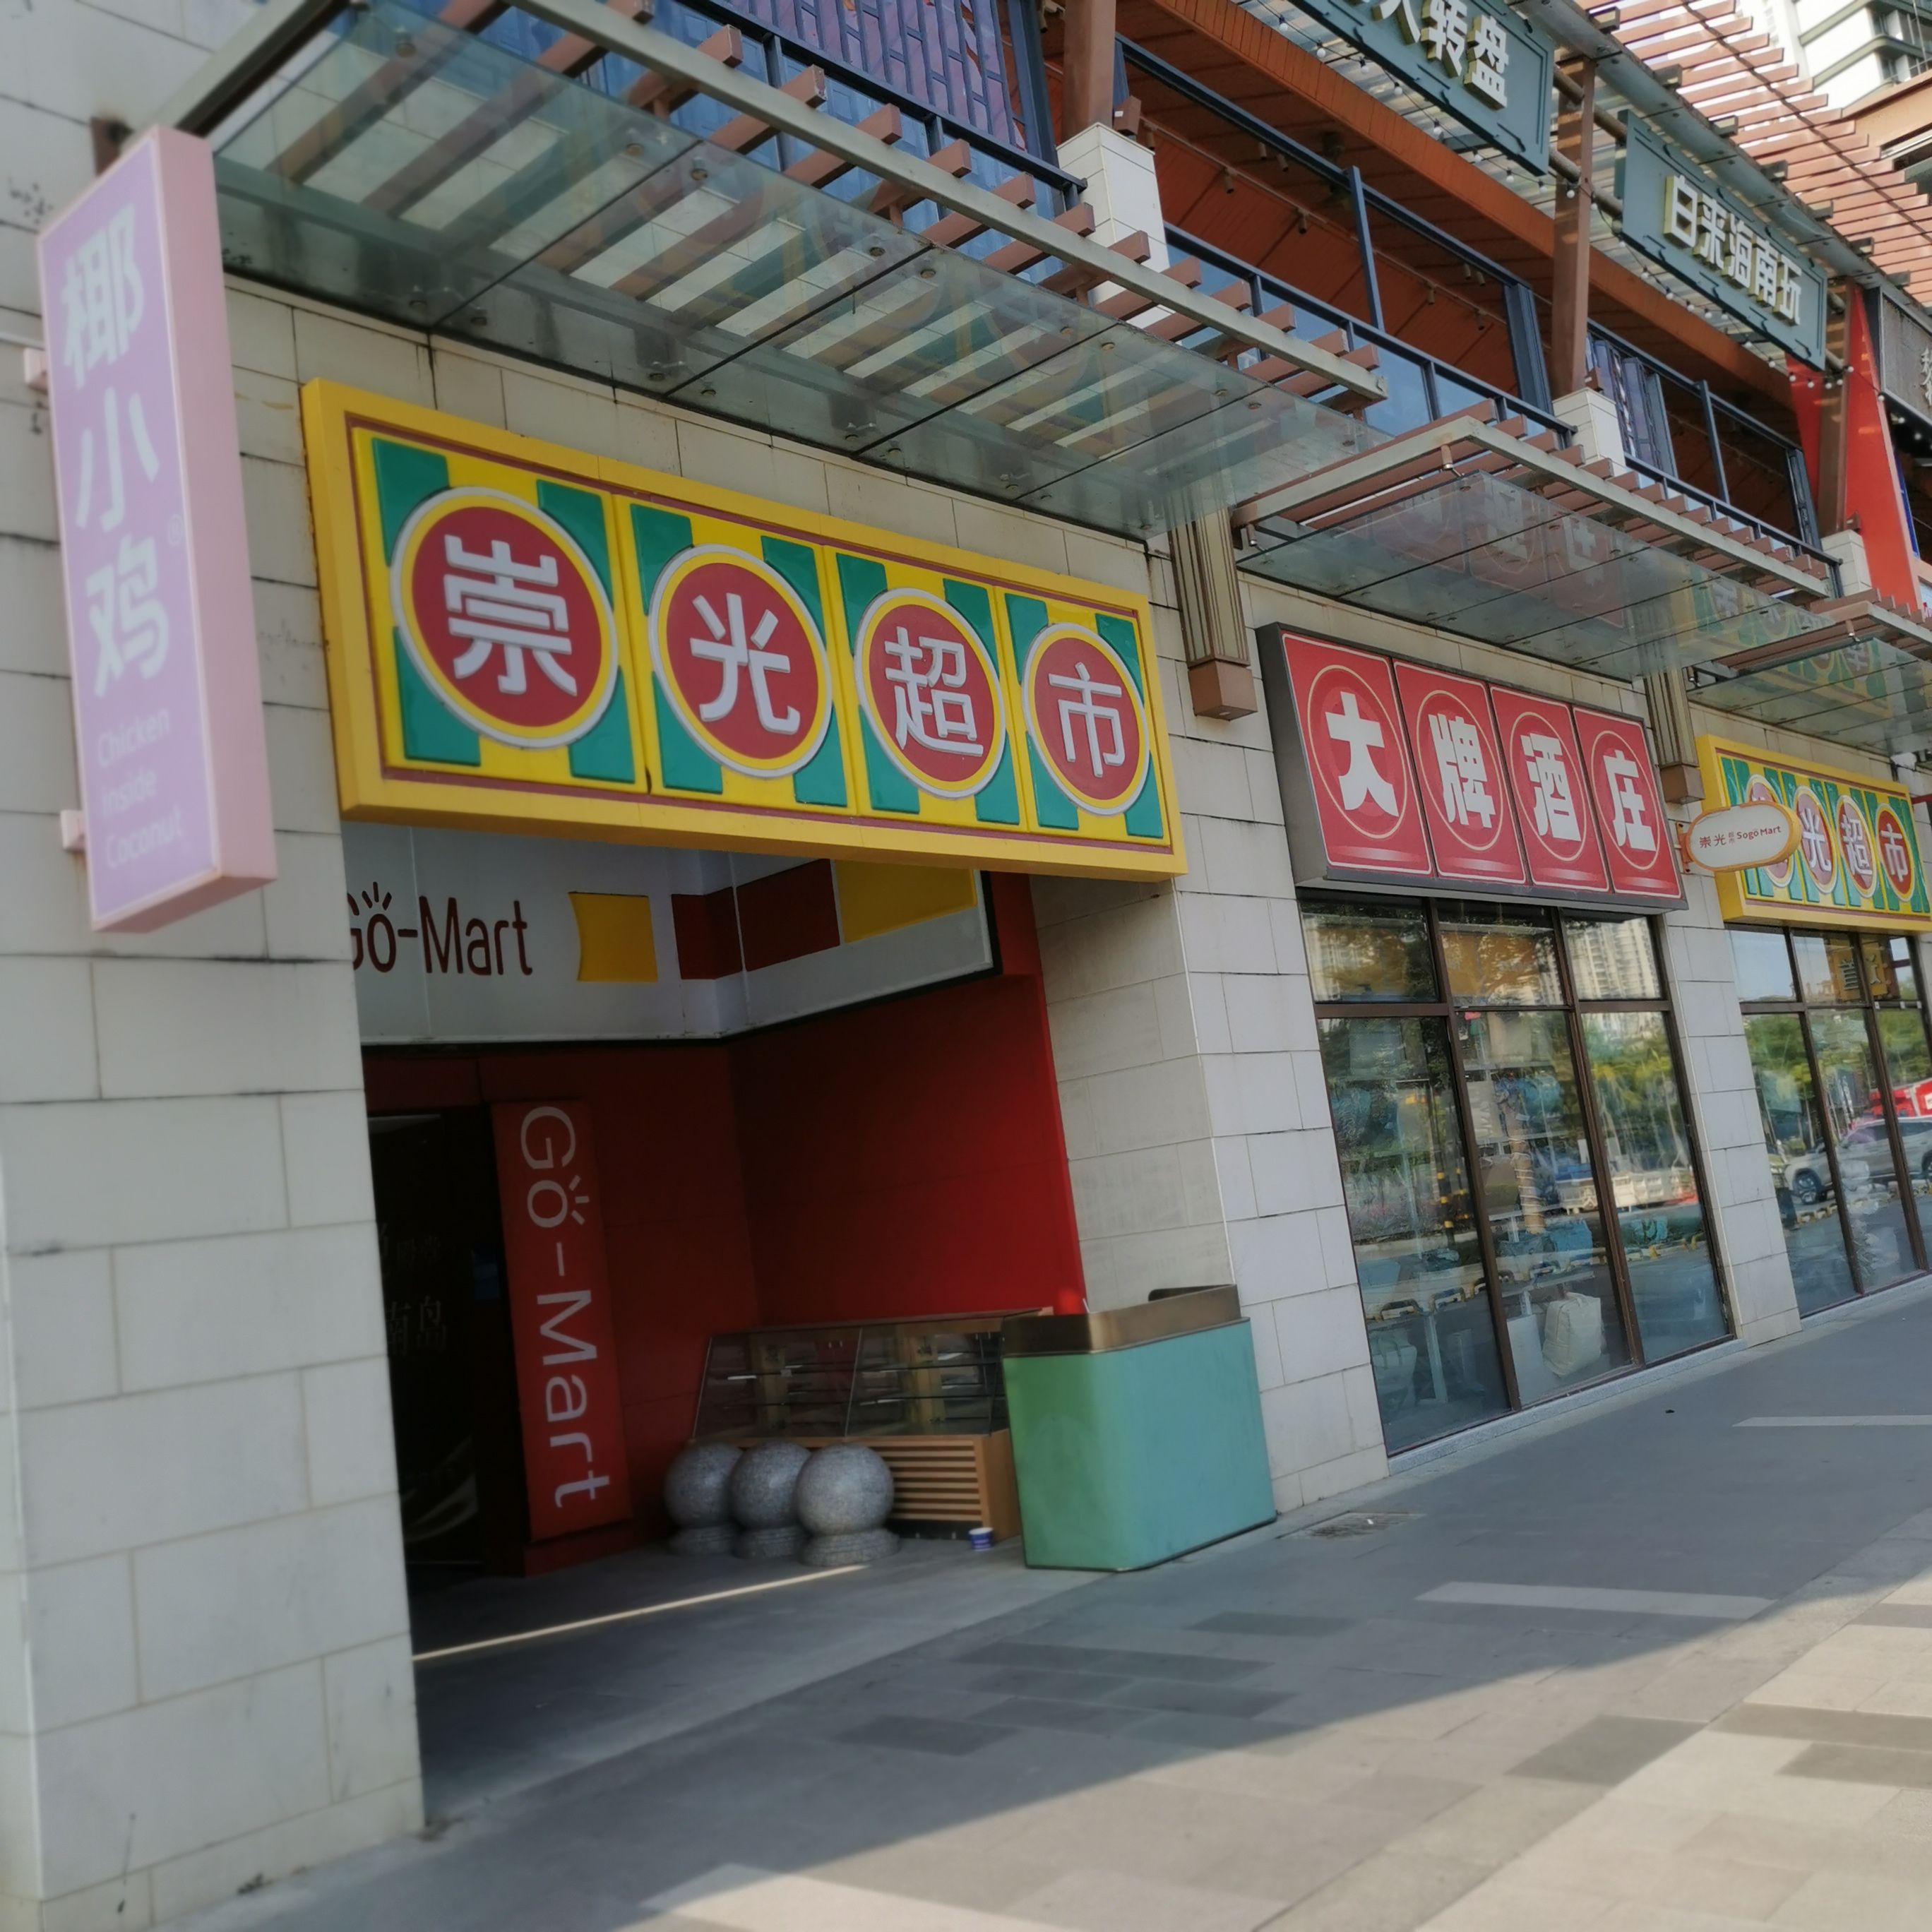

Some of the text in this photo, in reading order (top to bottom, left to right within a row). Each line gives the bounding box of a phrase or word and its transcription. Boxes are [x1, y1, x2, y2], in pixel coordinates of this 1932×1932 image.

[61, 202, 169, 697] 椰小鸡
[443, 534, 1126, 777] 崇光超市
[97, 708, 171, 768] Chicken
[1325, 691, 1657, 852] 大牌酒庄
[105, 803, 182, 870] Coconut
[1752, 796, 1909, 883] 光超市
